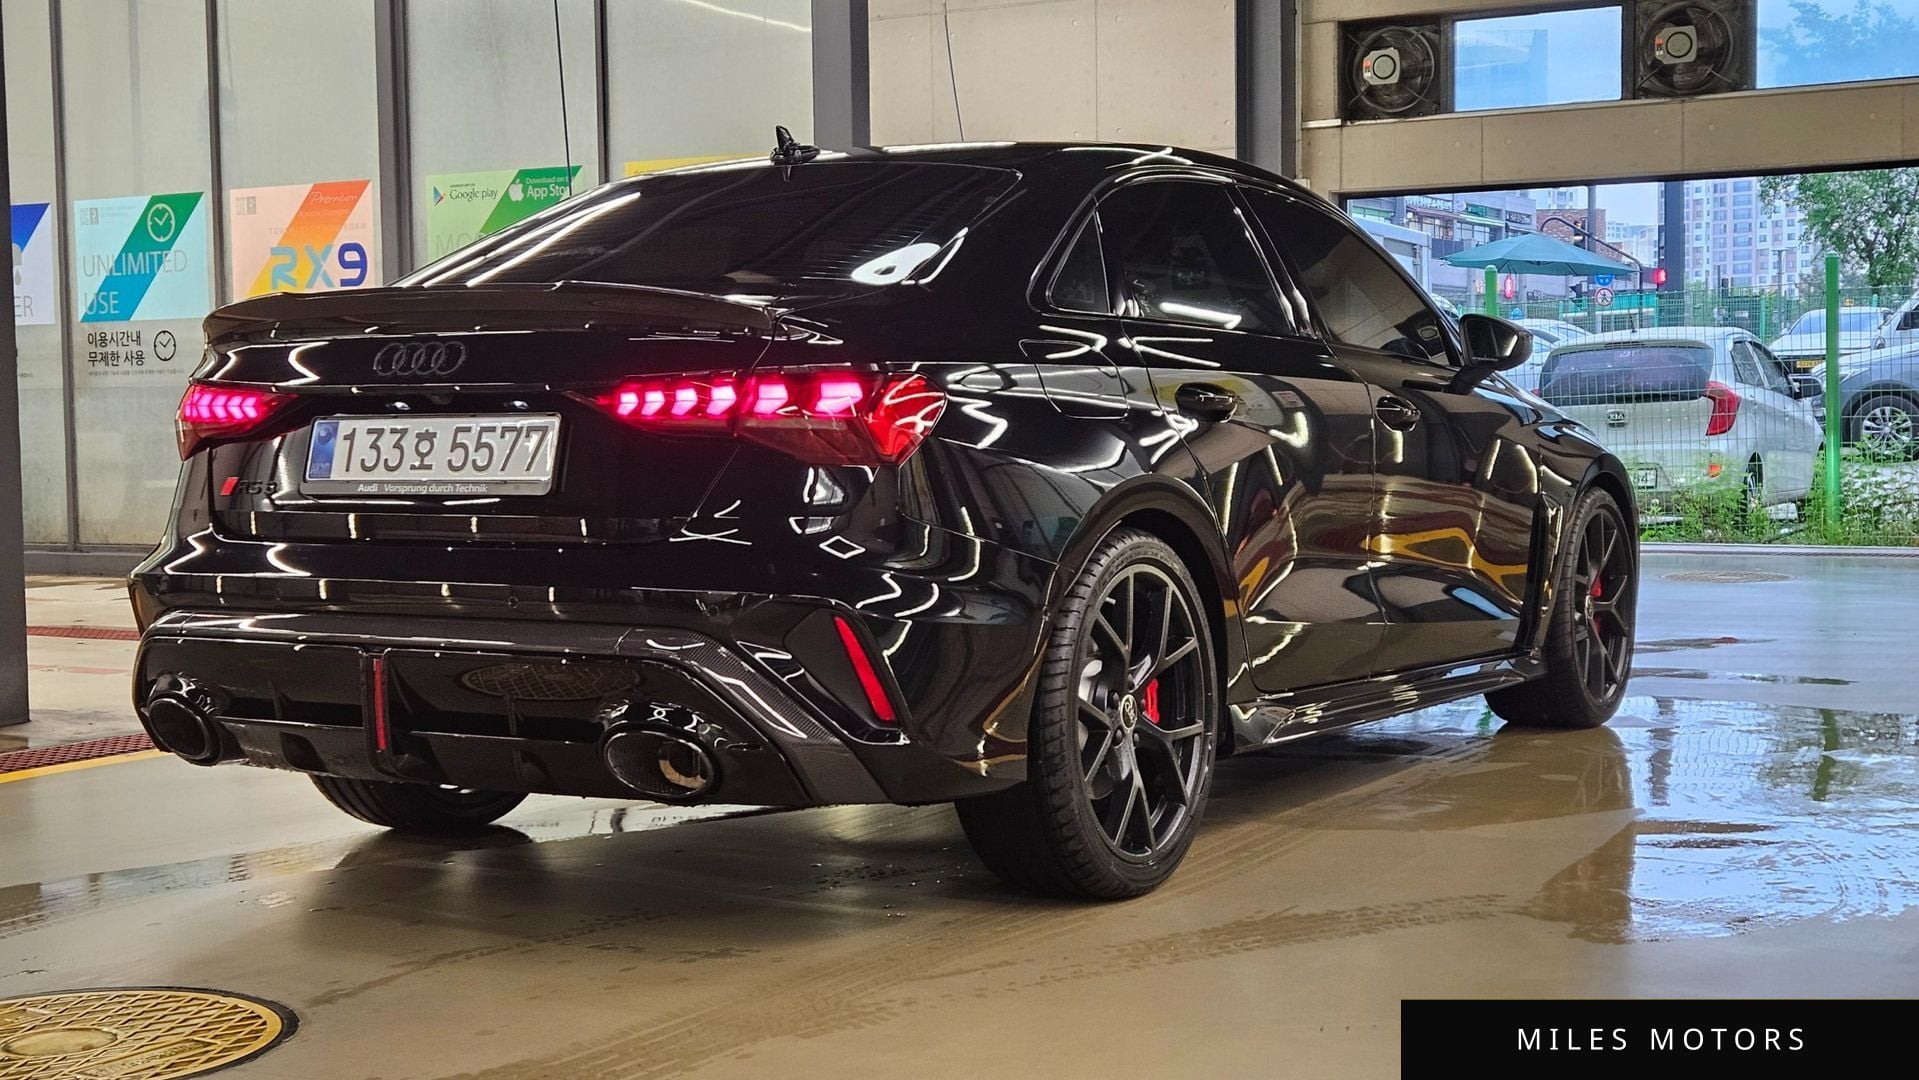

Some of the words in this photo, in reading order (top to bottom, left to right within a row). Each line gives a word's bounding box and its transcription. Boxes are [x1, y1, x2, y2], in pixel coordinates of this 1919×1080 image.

[525, 176, 556, 184] Download
[311, 191, 360, 205] Premium
[449, 187, 480, 202] Google
[481, 187, 498, 200] play
[526, 185, 548, 200] App
[83, 250, 188, 278] UNLIMITED
[270, 242, 368, 290] RX9
[84, 291, 121, 316] USE
[87, 329, 142, 349] 이용시간내
[87, 350, 121, 367] 무제한
[123, 350, 146, 367] 사용
[342, 427, 438, 473] 133호
[446, 425, 549, 473] 5577
[357, 484, 379, 492] Audi
[384, 484, 427, 494] Vorsprung
[428, 484, 454, 492] durch
[455, 484, 488, 493] Technik
